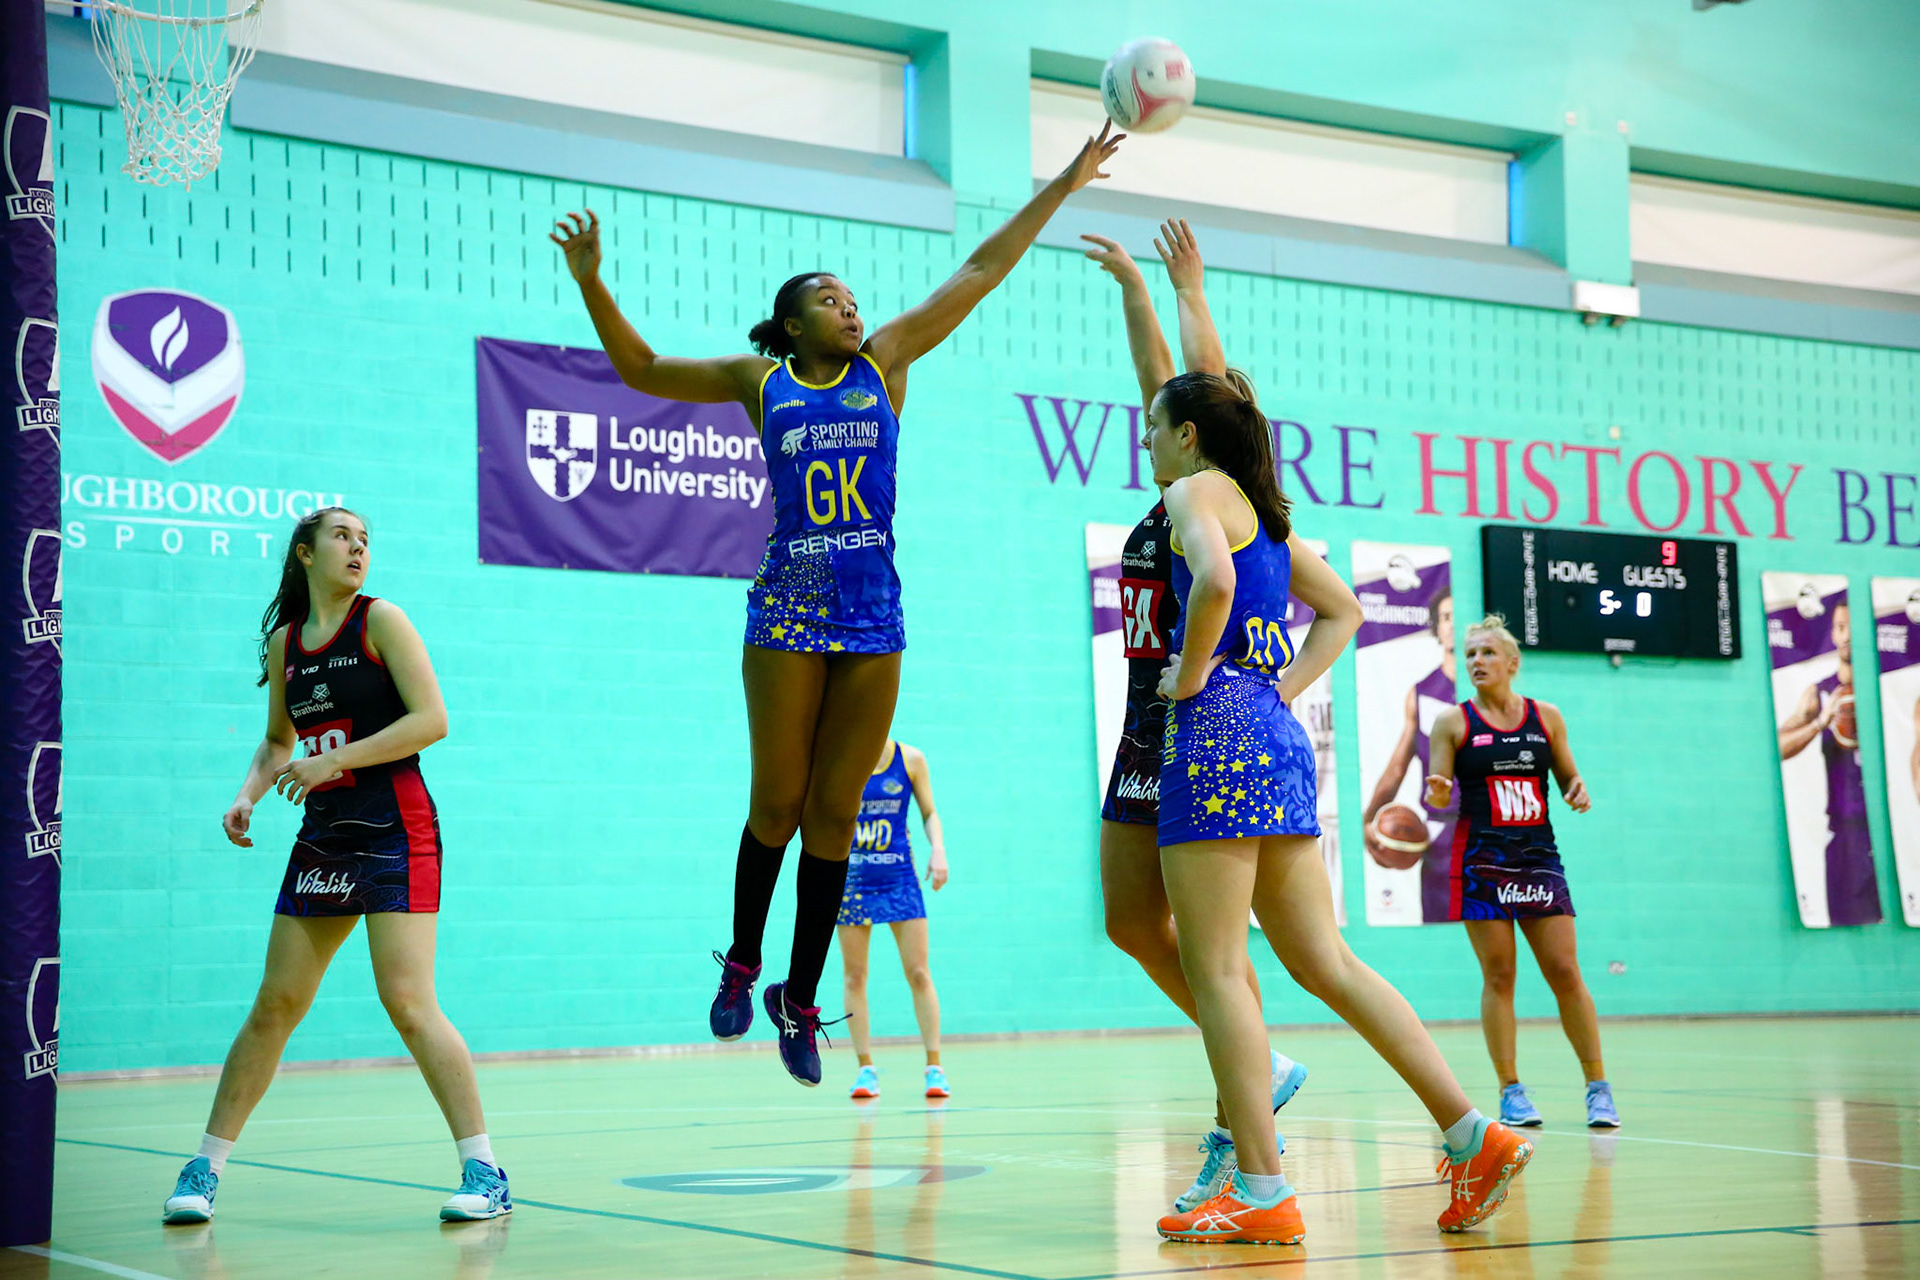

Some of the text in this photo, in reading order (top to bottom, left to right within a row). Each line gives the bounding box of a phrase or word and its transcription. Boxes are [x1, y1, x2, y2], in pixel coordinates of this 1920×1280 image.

[809, 421, 879, 441] SPORTING
[812, 438, 878, 451] FAMILY CHANGE
[609, 457, 768, 509] University
[805, 456, 872, 525] GK
[1411, 431, 1803, 541] HISTORY
[66, 520, 273, 559] SPORT
[1122, 557, 1156, 570] Strathclyde
[1661, 541, 1678, 566] 9
[1548, 561, 1687, 590] HOME GUESTS
[291, 701, 334, 719] Strathclyde
[1494, 780, 1542, 821] WA
[855, 818, 892, 852] WD
[849, 852, 905, 865] ENGEN
[295, 867, 356, 903] Vitality
[1496, 882, 1554, 908] Vitality
[32, 1050, 59, 1071] LIG
